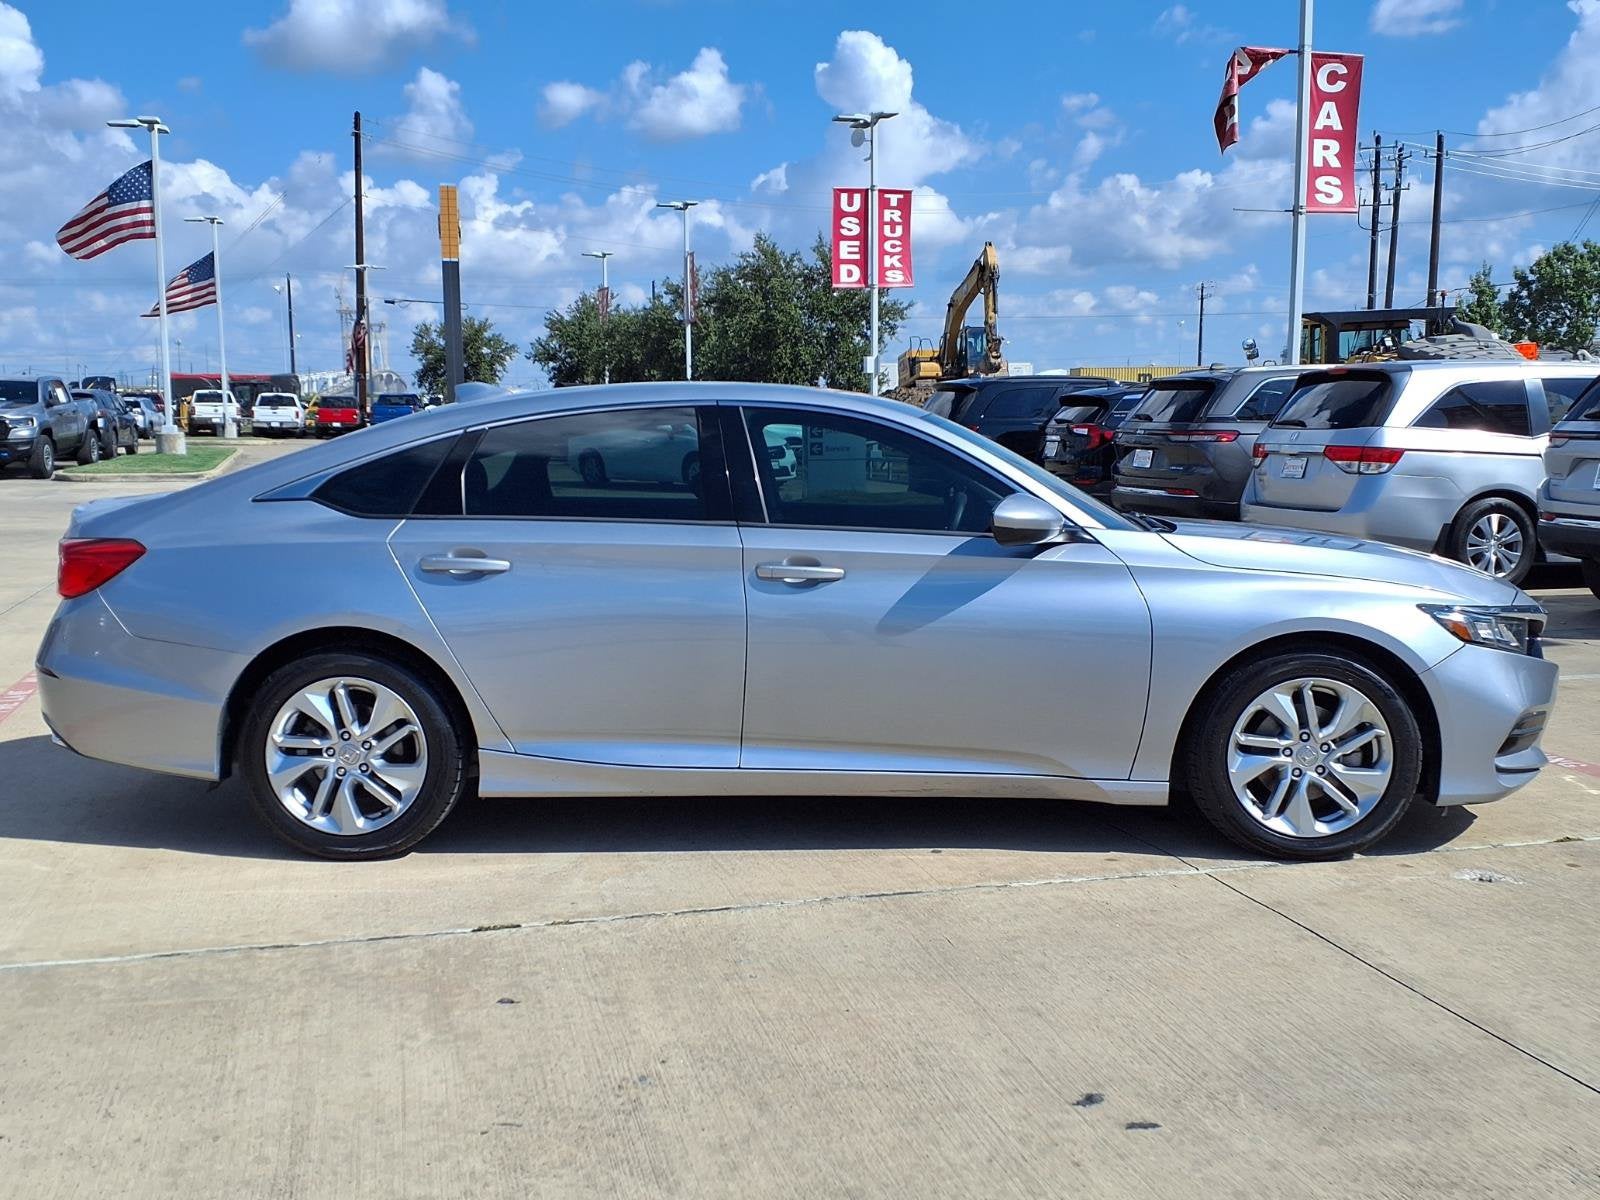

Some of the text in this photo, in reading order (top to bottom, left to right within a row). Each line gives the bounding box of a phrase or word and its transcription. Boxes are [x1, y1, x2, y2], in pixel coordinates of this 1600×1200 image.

[1312, 62, 1349, 205] CARS
[839, 192, 861, 283] USED
[883, 193, 904, 283] TRUCKS
